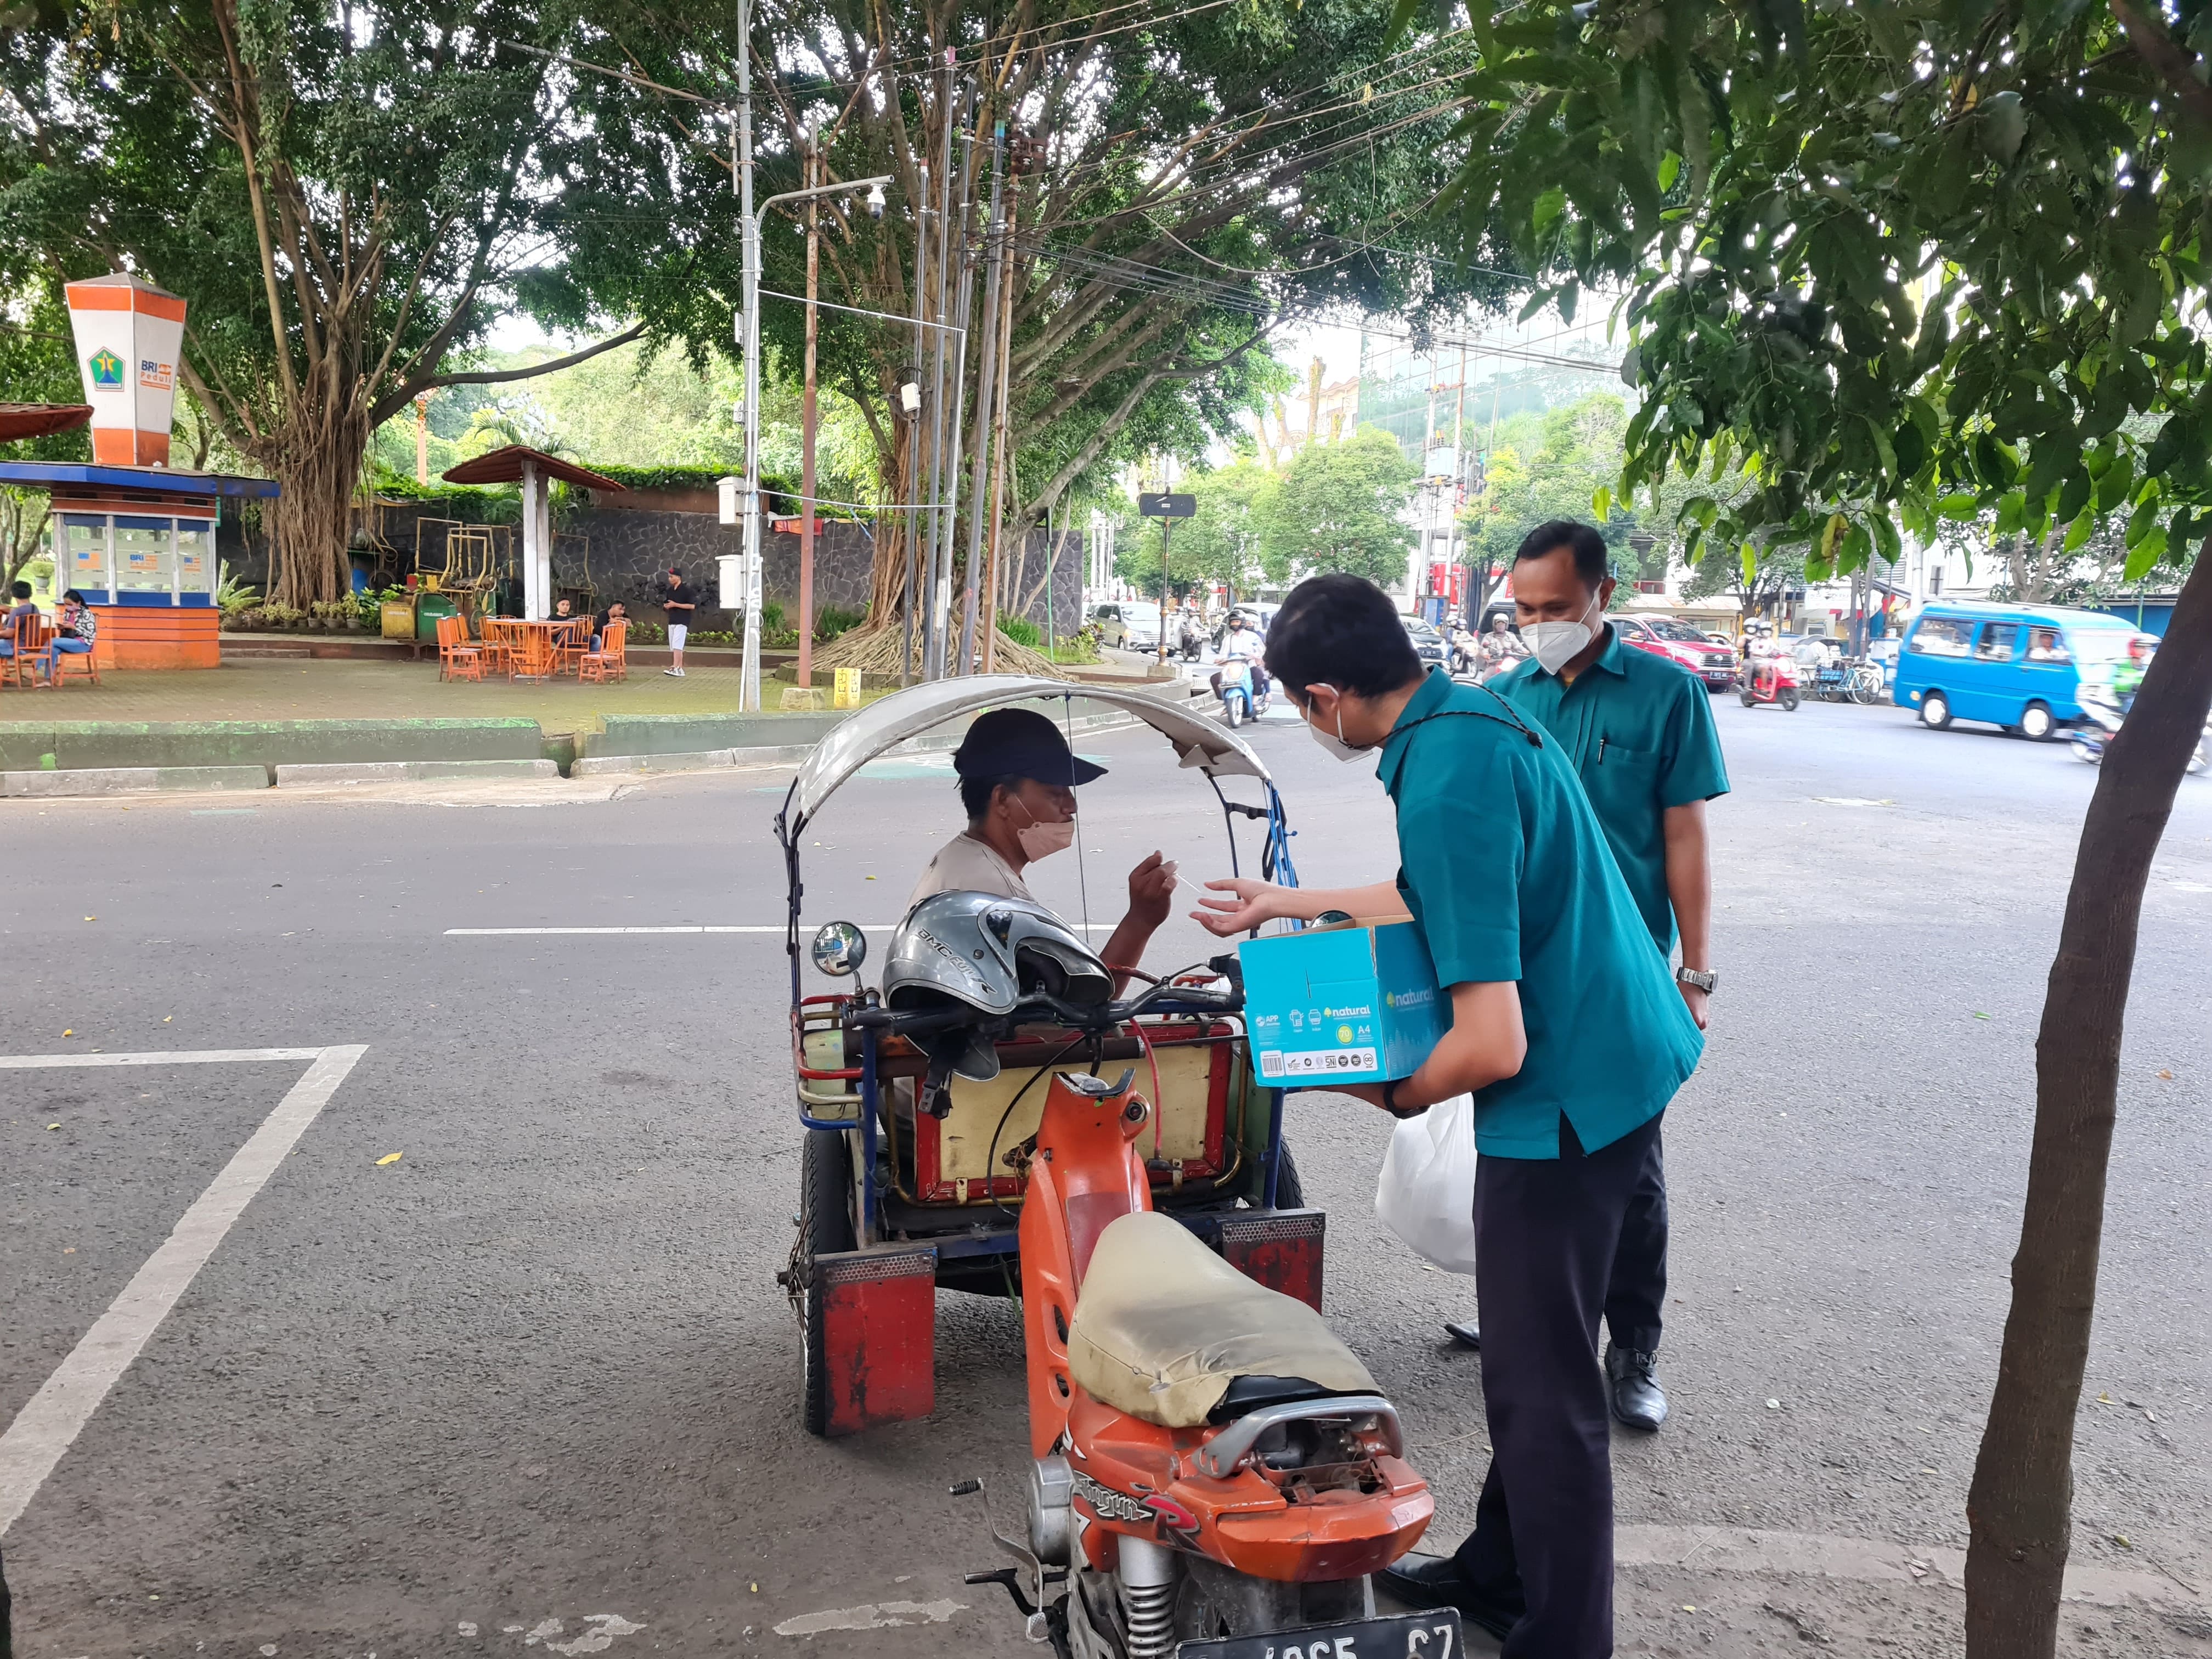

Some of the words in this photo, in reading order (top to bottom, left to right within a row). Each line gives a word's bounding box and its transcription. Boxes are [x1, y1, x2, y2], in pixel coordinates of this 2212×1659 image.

[142, 360, 157, 373] BRI
[140, 371, 171, 383] Peduli
[918, 928, 953, 958] BMC
[1395, 986, 1435, 1007] natural
[1332, 1005, 1371, 1017] natural
[1340, 1029, 1350, 1037] 70
[1358, 1024, 1371, 1034] A4
[1325, 1057, 1336, 1066] SNI
